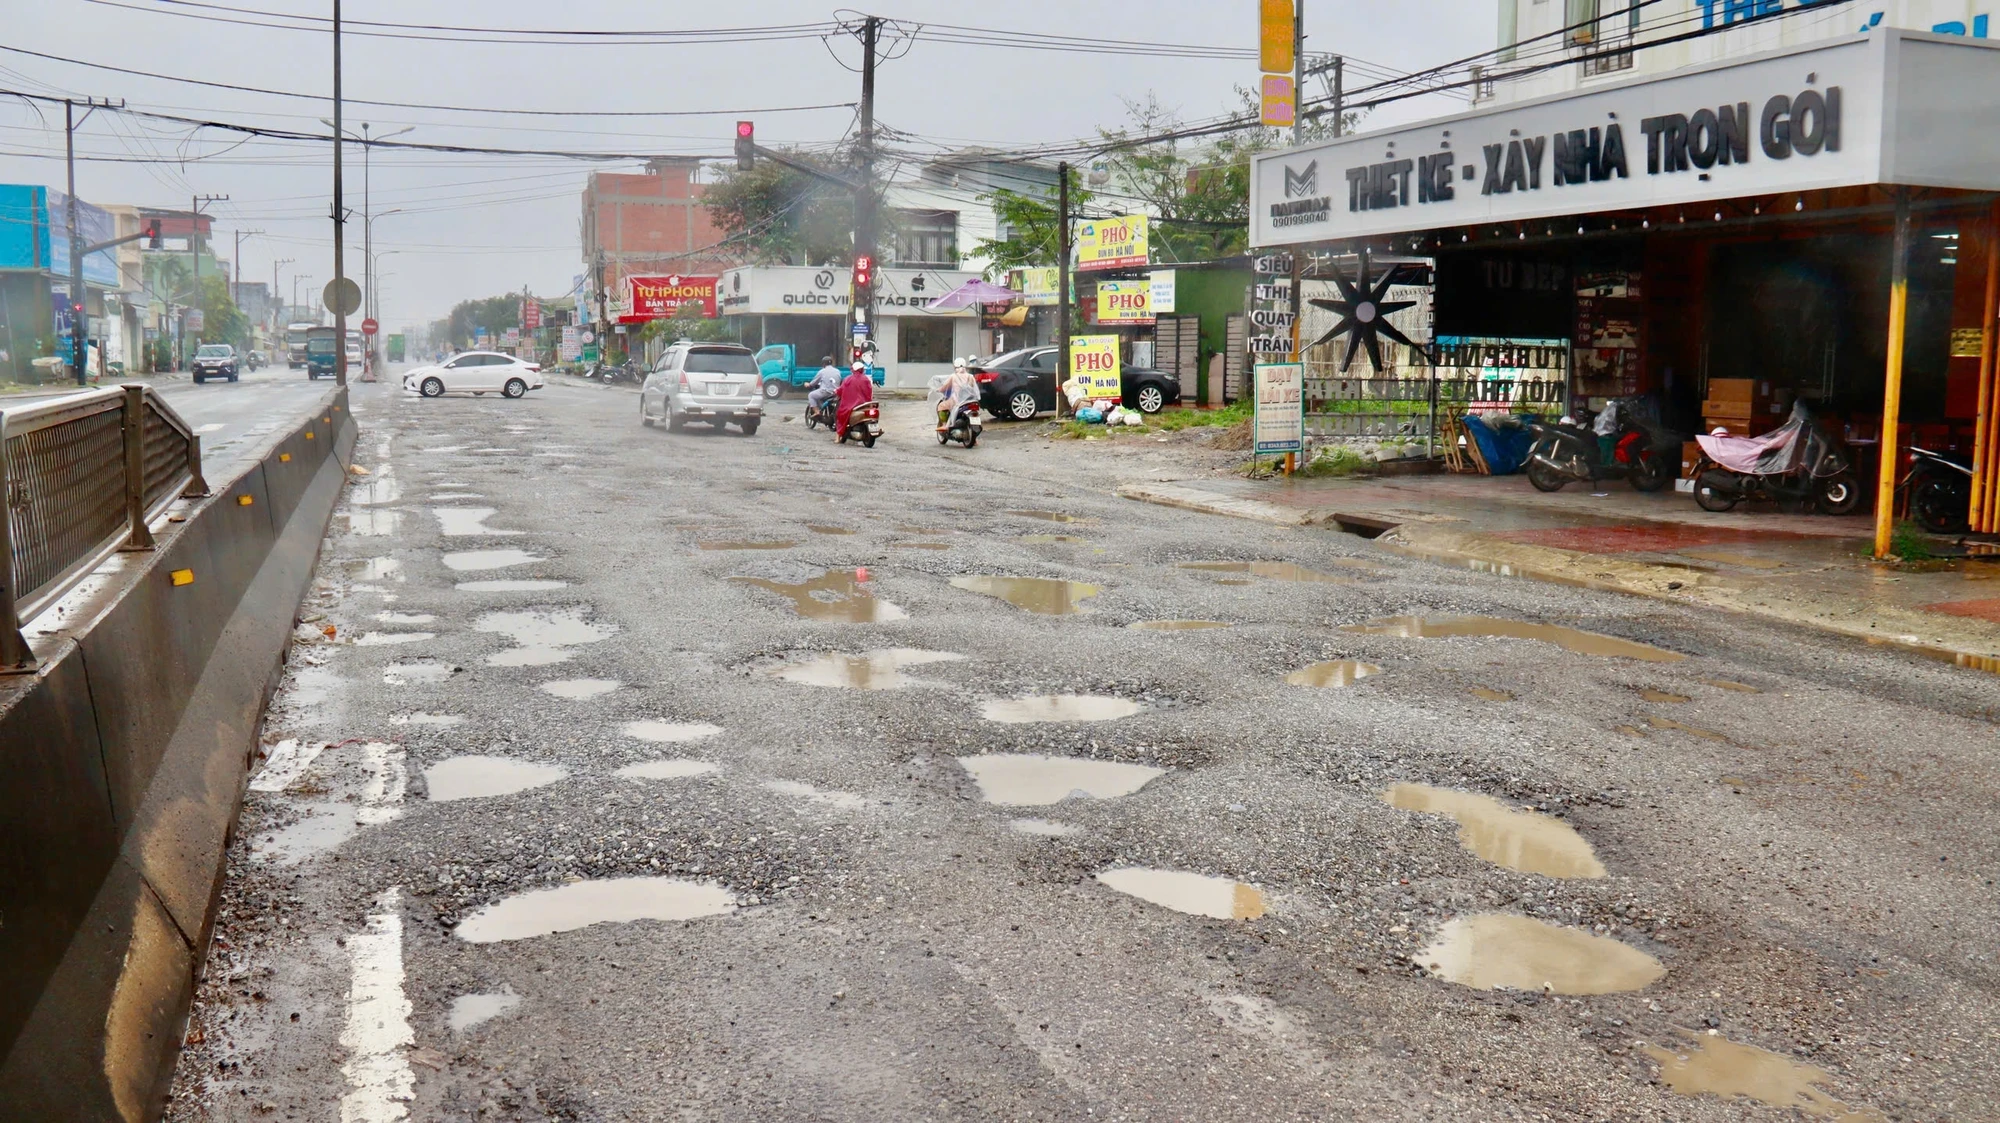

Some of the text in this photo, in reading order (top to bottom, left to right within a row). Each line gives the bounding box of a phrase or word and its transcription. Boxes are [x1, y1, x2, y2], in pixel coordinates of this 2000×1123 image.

[1554, 112, 1629, 186] NHÀ
[1641, 102, 1749, 181] TRỌN
[1760, 72, 1841, 160] GÓI
[1260, 256, 1292, 273] SIÊU
[659, 286, 712, 297] IPHONE
[1263, 285, 1287, 303] THỊ
[1254, 311, 1294, 329] QUẠT
